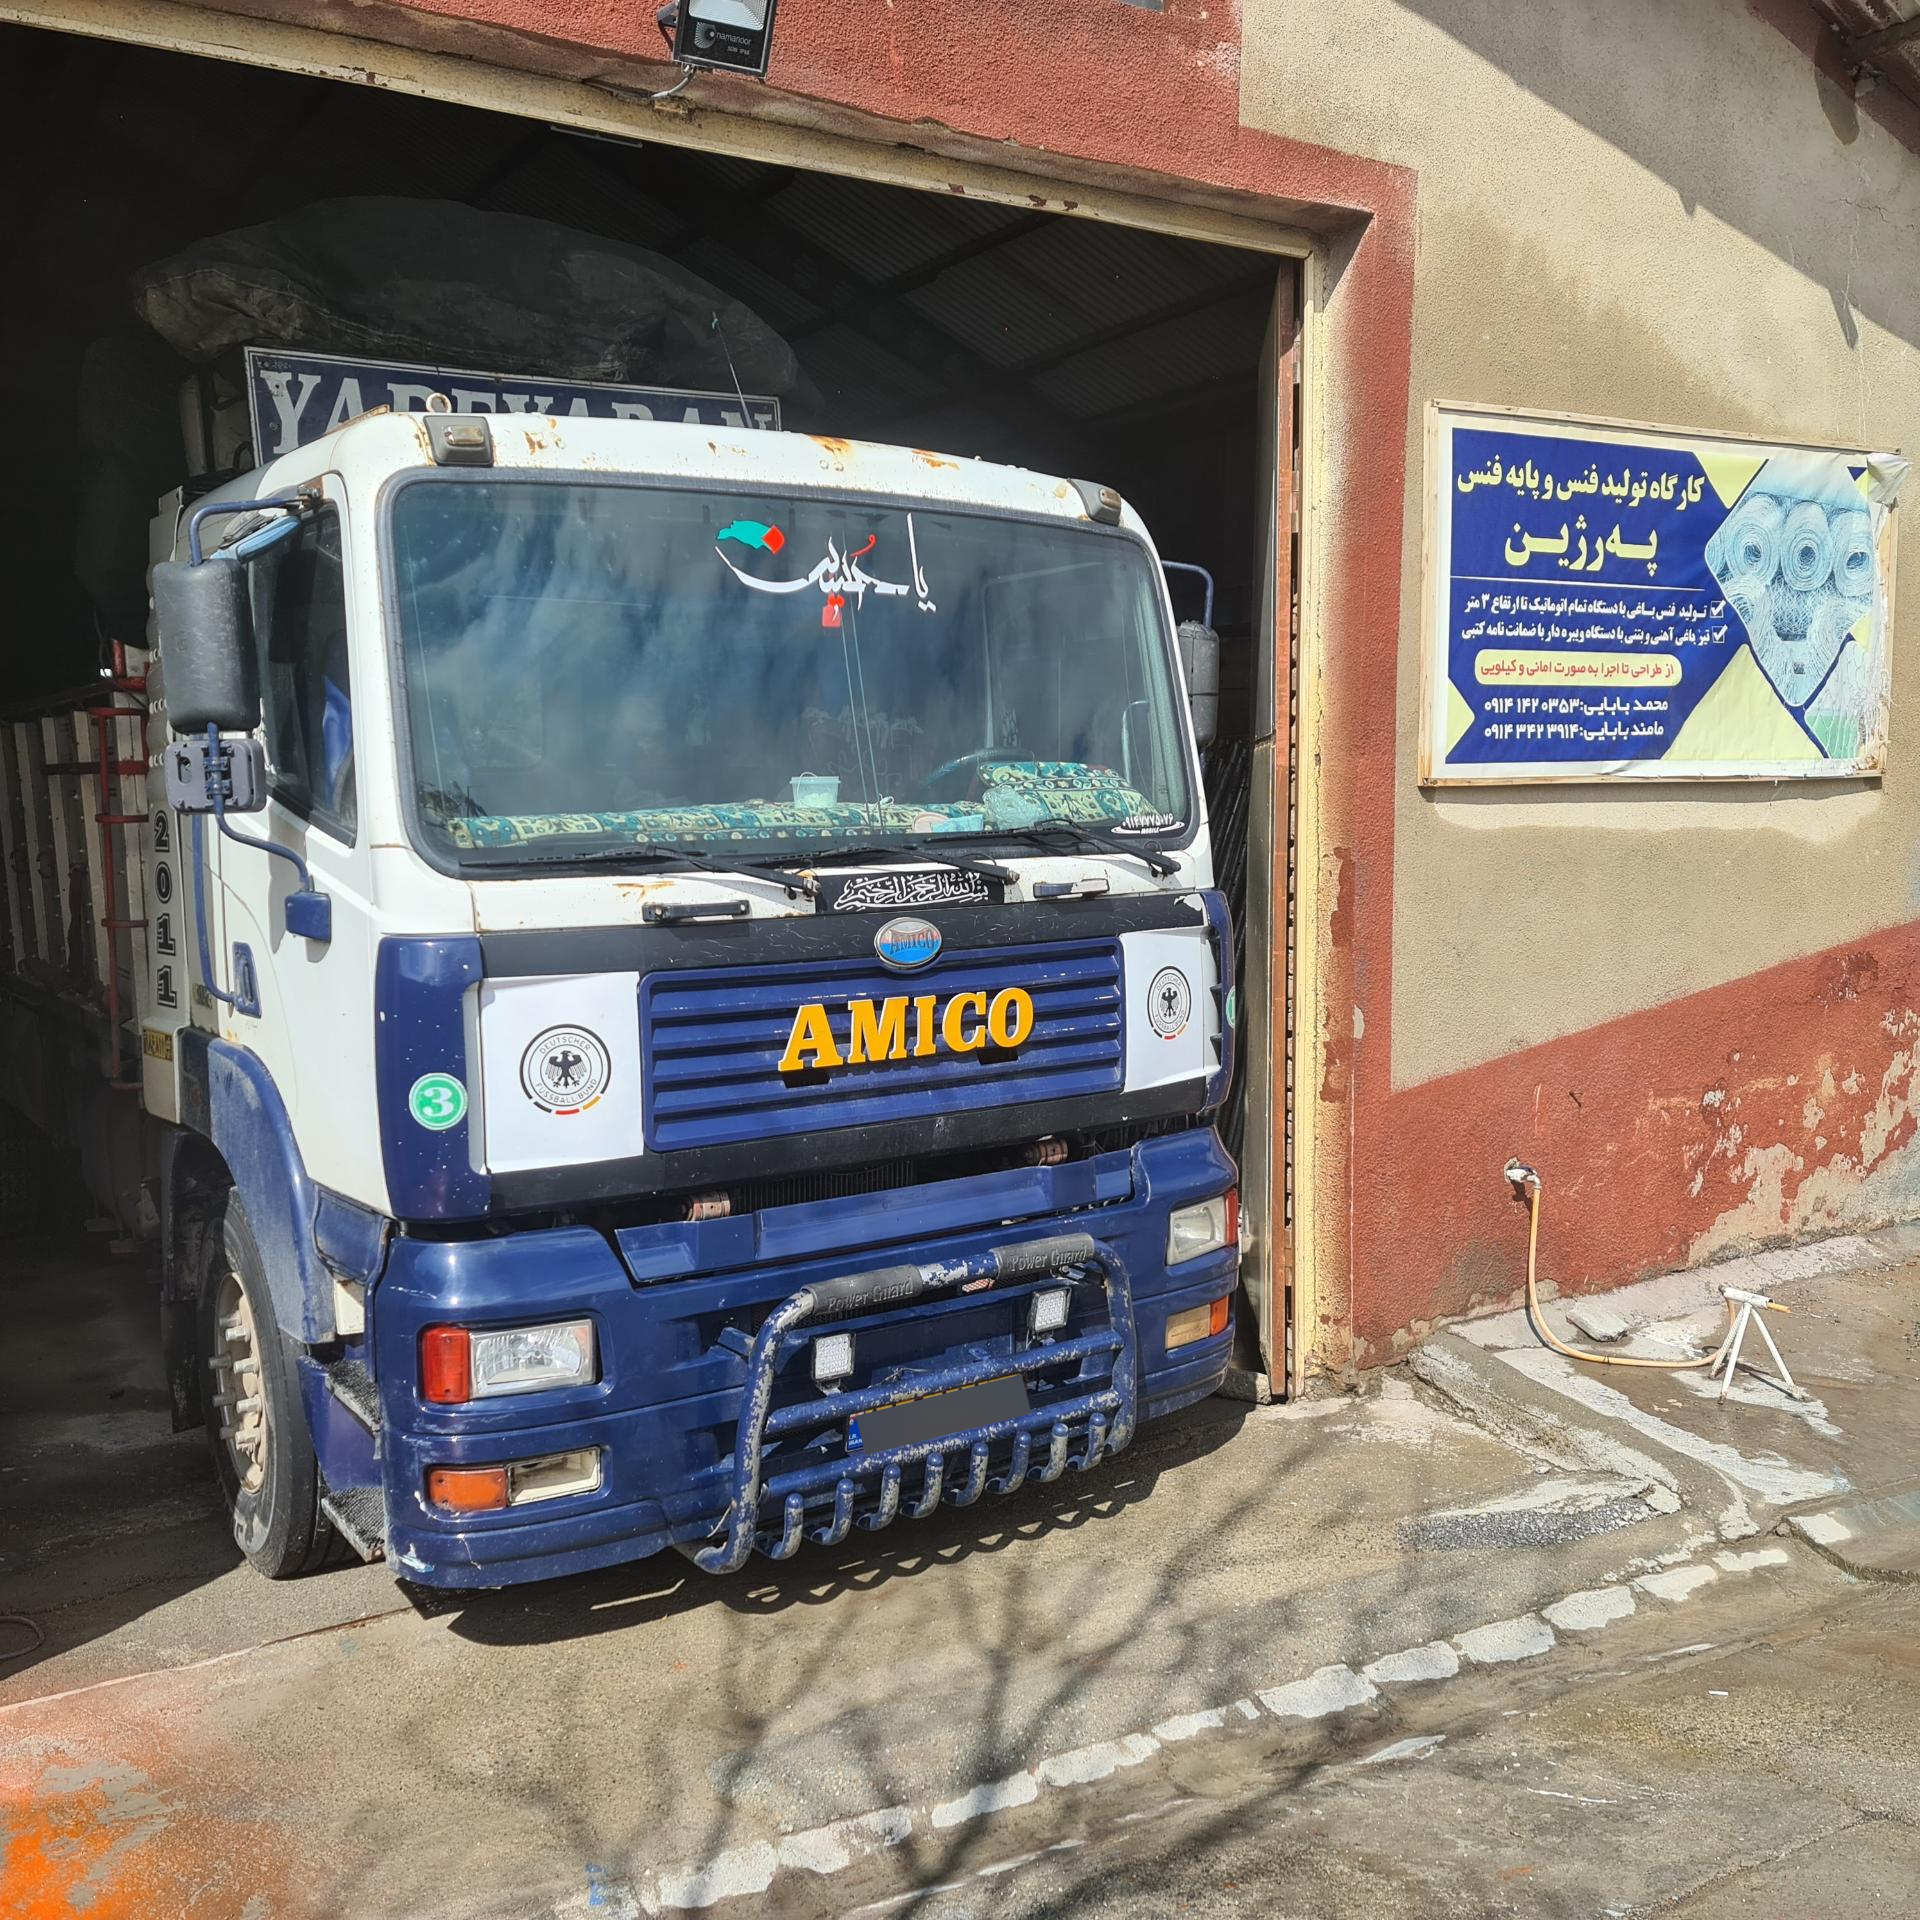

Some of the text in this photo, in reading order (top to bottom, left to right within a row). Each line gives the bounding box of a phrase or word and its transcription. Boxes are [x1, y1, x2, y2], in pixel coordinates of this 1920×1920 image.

[1457, 454, 1705, 511] کارگاه تولید فنس و پایه فنس
[1464, 596, 1481, 613] متر
[1491, 594, 1520, 615] ارتفاع
[1520, 596, 1529, 611] تا
[1528, 597, 1568, 616] اتوماتیک
[1568, 598, 1588, 616] تمام
[1587, 599, 1618, 615] دستگاه
[1618, 600, 1627, 618] با
[1626, 602, 1656, 620] باغی
[1655, 602, 1676, 620] فنس
[1678, 604, 1707, 621] تولید
[1461, 620, 1486, 640] کتبی
[1486, 621, 1505, 636] نامه
[1505, 621, 1537, 637] ضمانت
[1537, 622, 1545, 641] با
[1544, 623, 1561, 642] دار
[1585, 625, 1616, 640] دستگاه
[1616, 626, 1624, 643] با
[1624, 628, 1644, 644] بتنی
[1650, 626, 1674, 645] آهنی
[1674, 629, 1697, 646] باغی
[1643, 631, 1650, 645] و
[1480, 659, 1674, 678] از طراحی تا اجرا به صورت امانی و کیلویی
[1633, 699, 1669, 711] محمد
[1630, 721, 1665, 736] مامند
[889, 928, 935, 954] AMICO
[778, 987, 1034, 1072] AMICO
[539, 1036, 591, 1055] DEUTSCHER
[423, 1087, 454, 1116] 3
[1011, 1246, 1088, 1272] Power Guard
[828, 1277, 914, 1311] Power Guard
